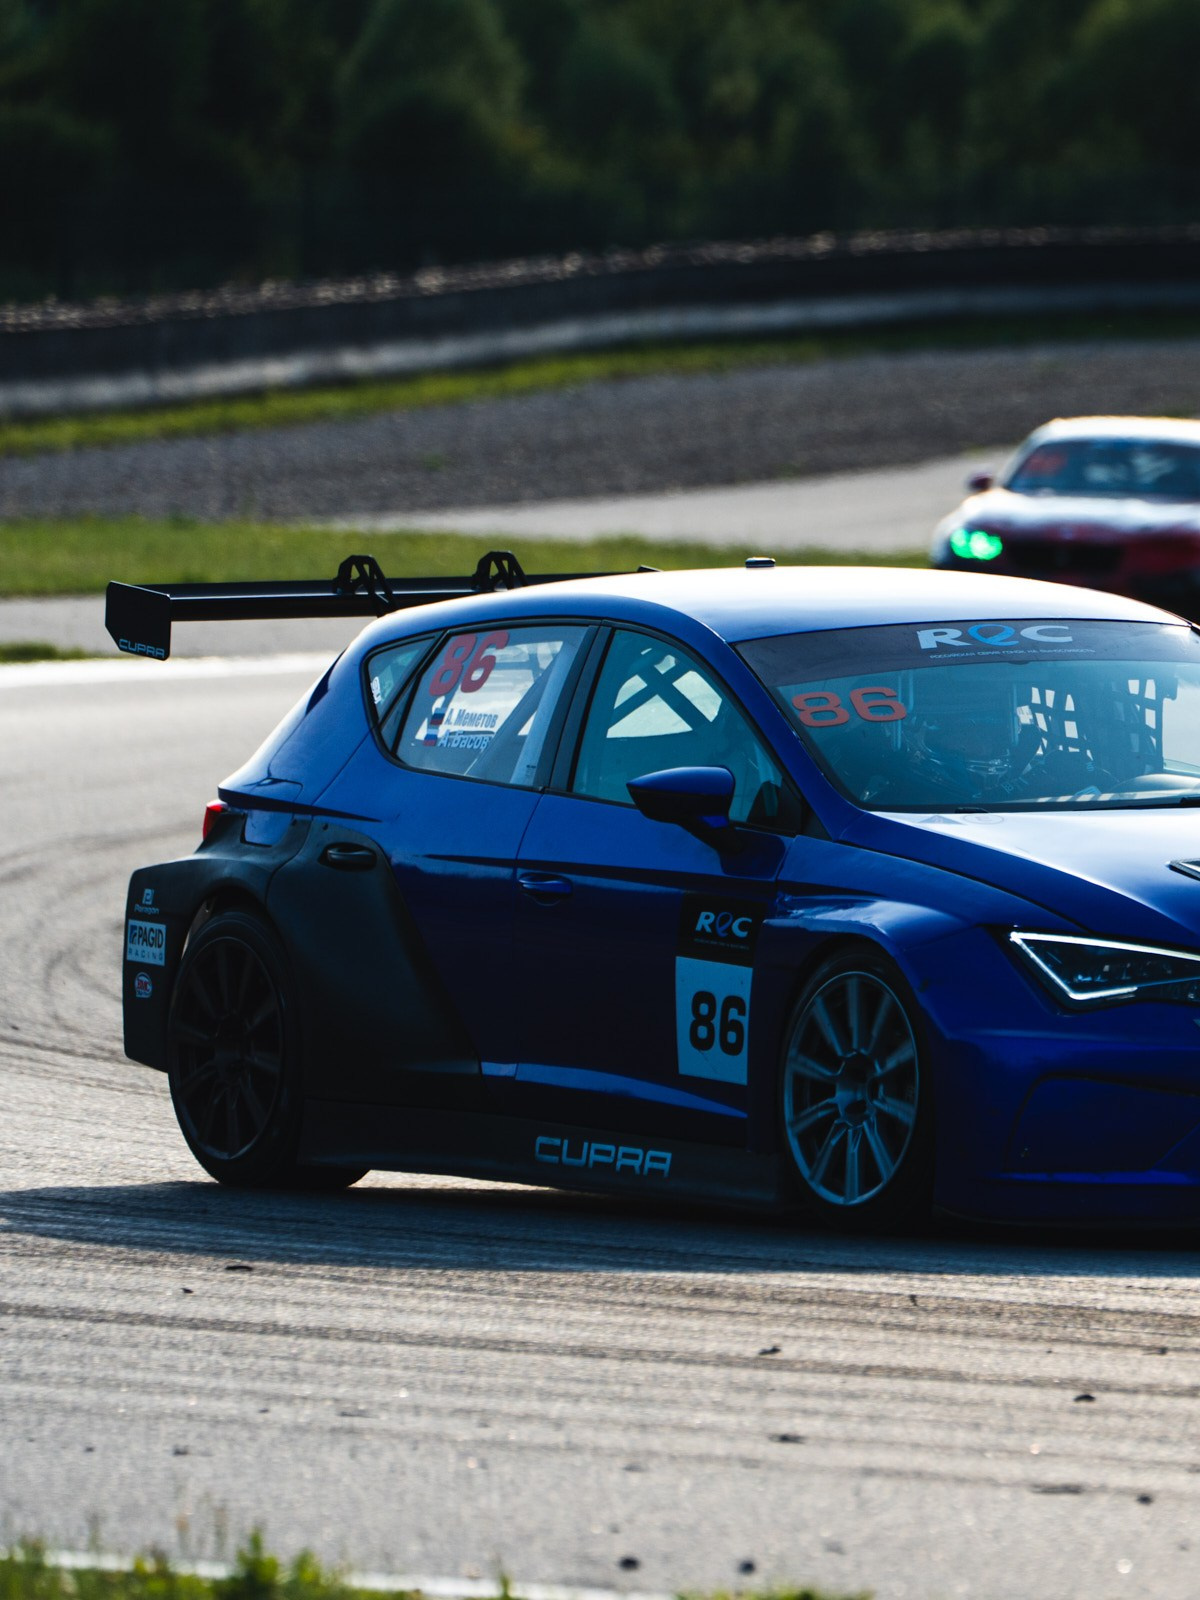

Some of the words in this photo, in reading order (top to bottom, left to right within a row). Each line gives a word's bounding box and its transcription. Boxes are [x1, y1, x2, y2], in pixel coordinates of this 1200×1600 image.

[118, 638, 165, 659] CUPRA
[429, 631, 509, 696] 86
[791, 687, 907, 728] 86
[128, 949, 164, 961] RACING
[137, 927, 164, 949] PAGID
[689, 991, 747, 1056] 86
[534, 1136, 672, 1178] CUPRA
